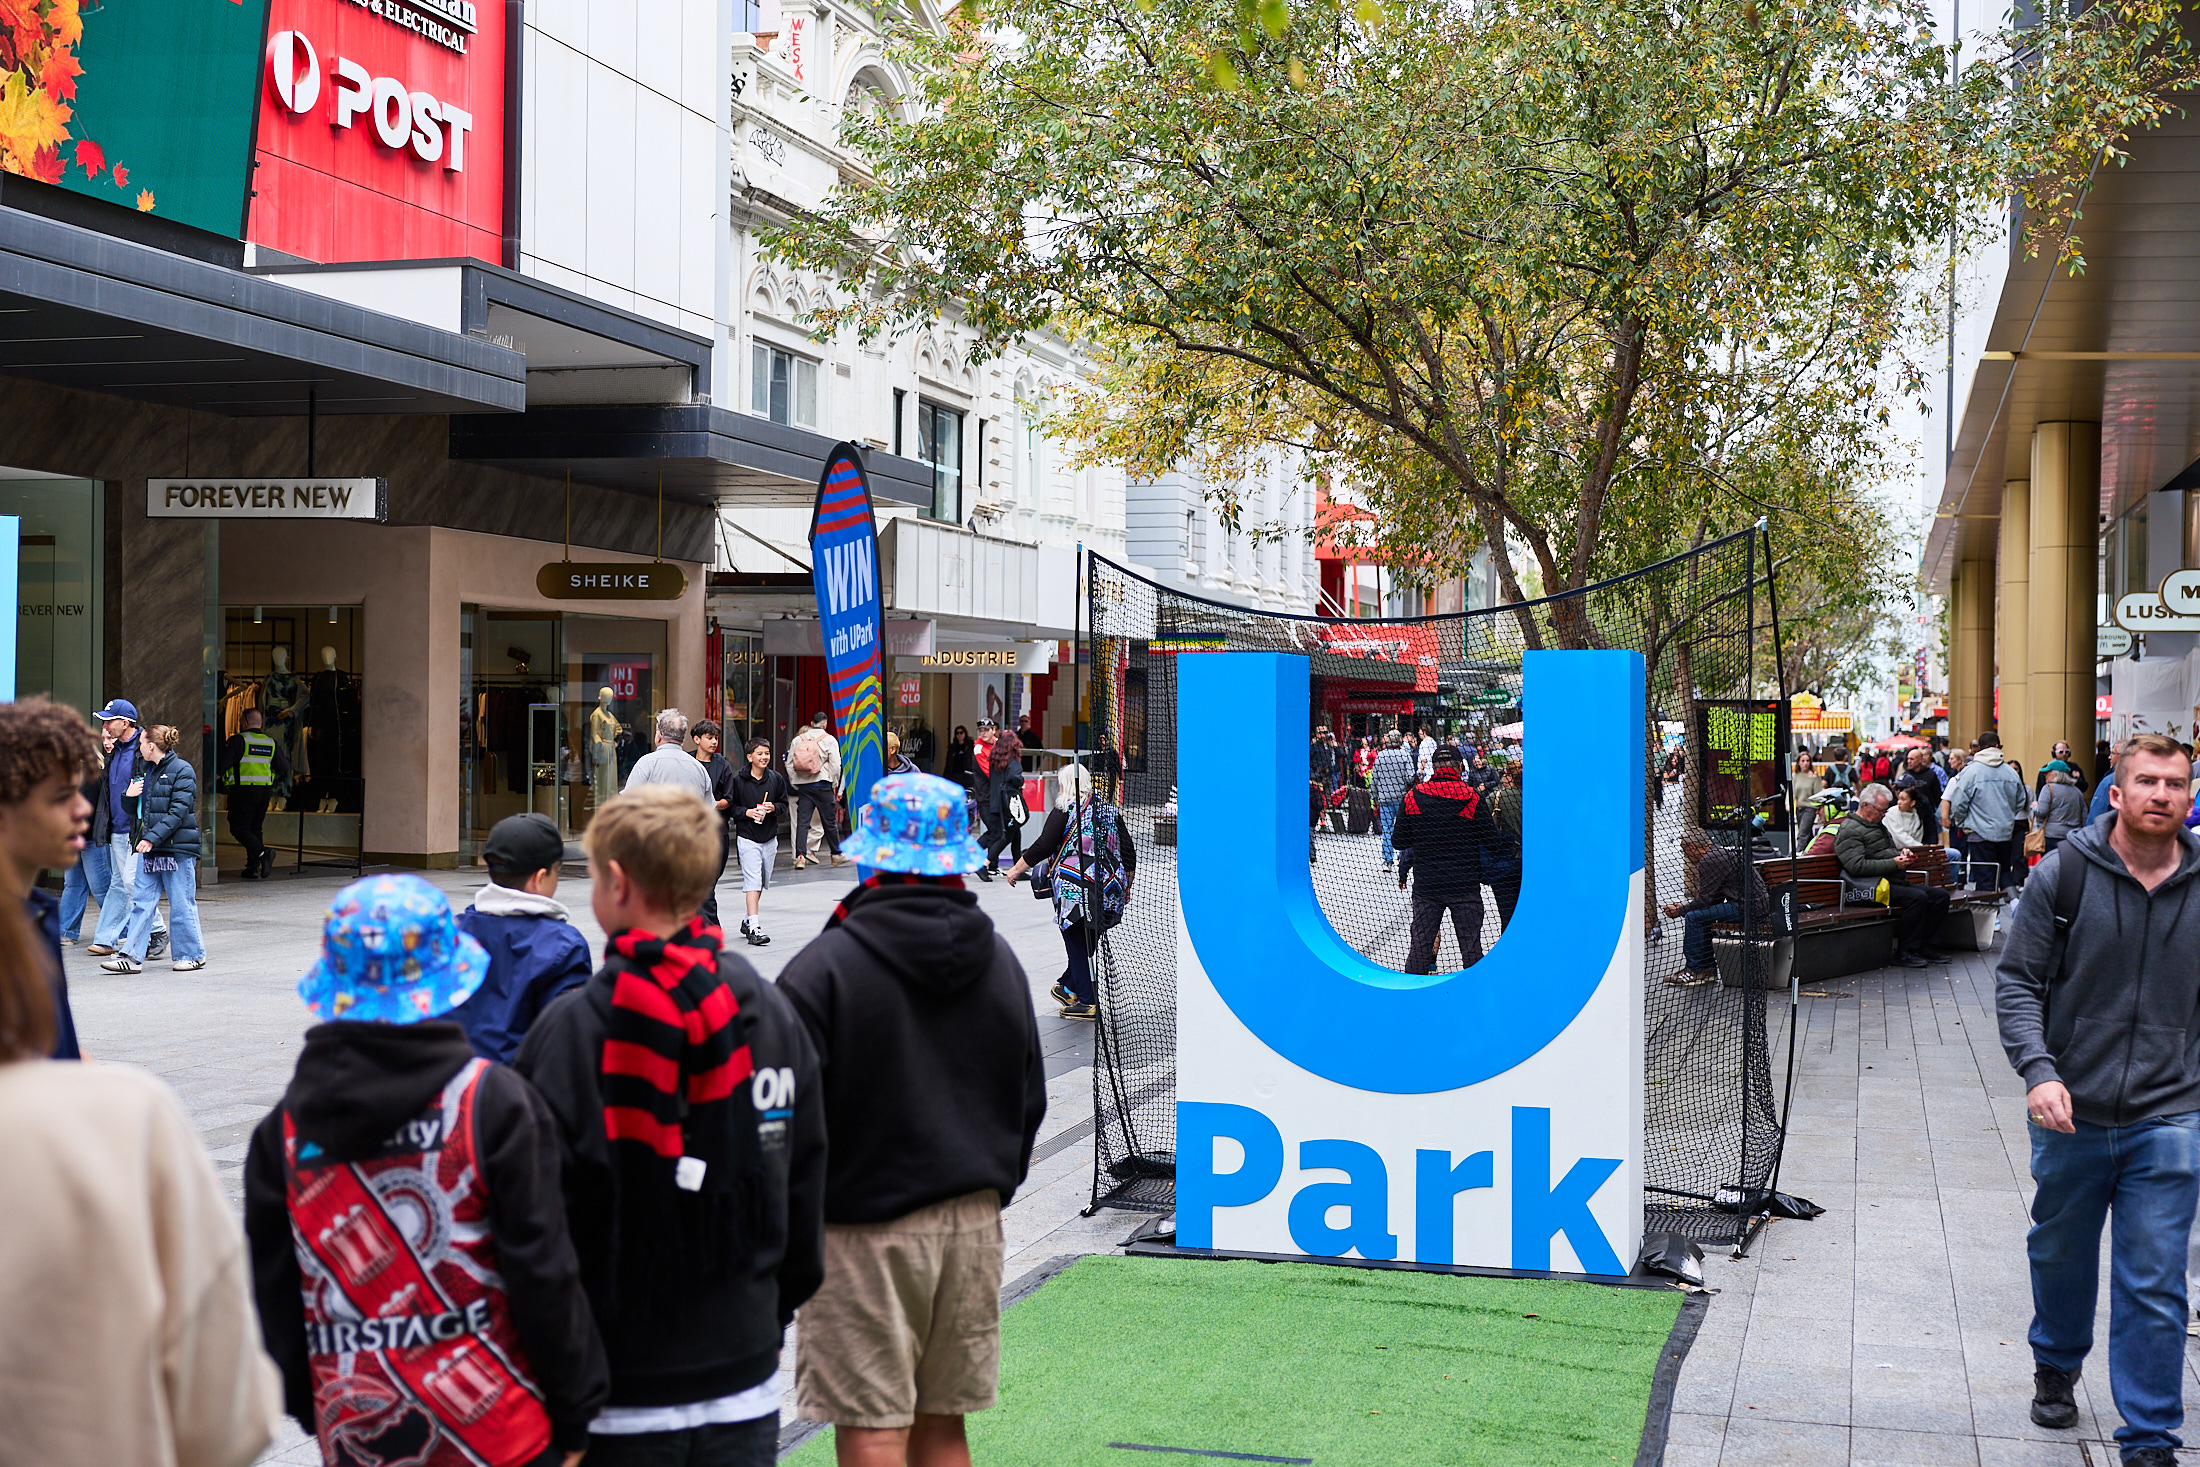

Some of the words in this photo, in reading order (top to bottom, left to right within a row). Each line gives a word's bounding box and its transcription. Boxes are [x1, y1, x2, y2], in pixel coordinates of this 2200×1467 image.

[385, 0, 467, 55] ELECTRICAL
[331, 56, 473, 173] POST
[165, 486, 285, 508] FOREVER
[293, 486, 353, 509] NEW
[570, 574, 649, 588] SHEIKE
[824, 535, 873, 616] WIN
[56, 604, 84, 616] NEW
[2126, 605, 2182, 619] LUS
[850, 616, 873, 651] UPark
[921, 650, 1017, 666] INDUSTRIE
[901, 693, 921, 704] QLO
[902, 683, 920, 692] UNI
[1177, 648, 1645, 1094] U
[1784, 913, 1793, 931] basics
[1176, 1100, 1630, 1277] Park
[305, 1297, 493, 1354] IRSTAGE
